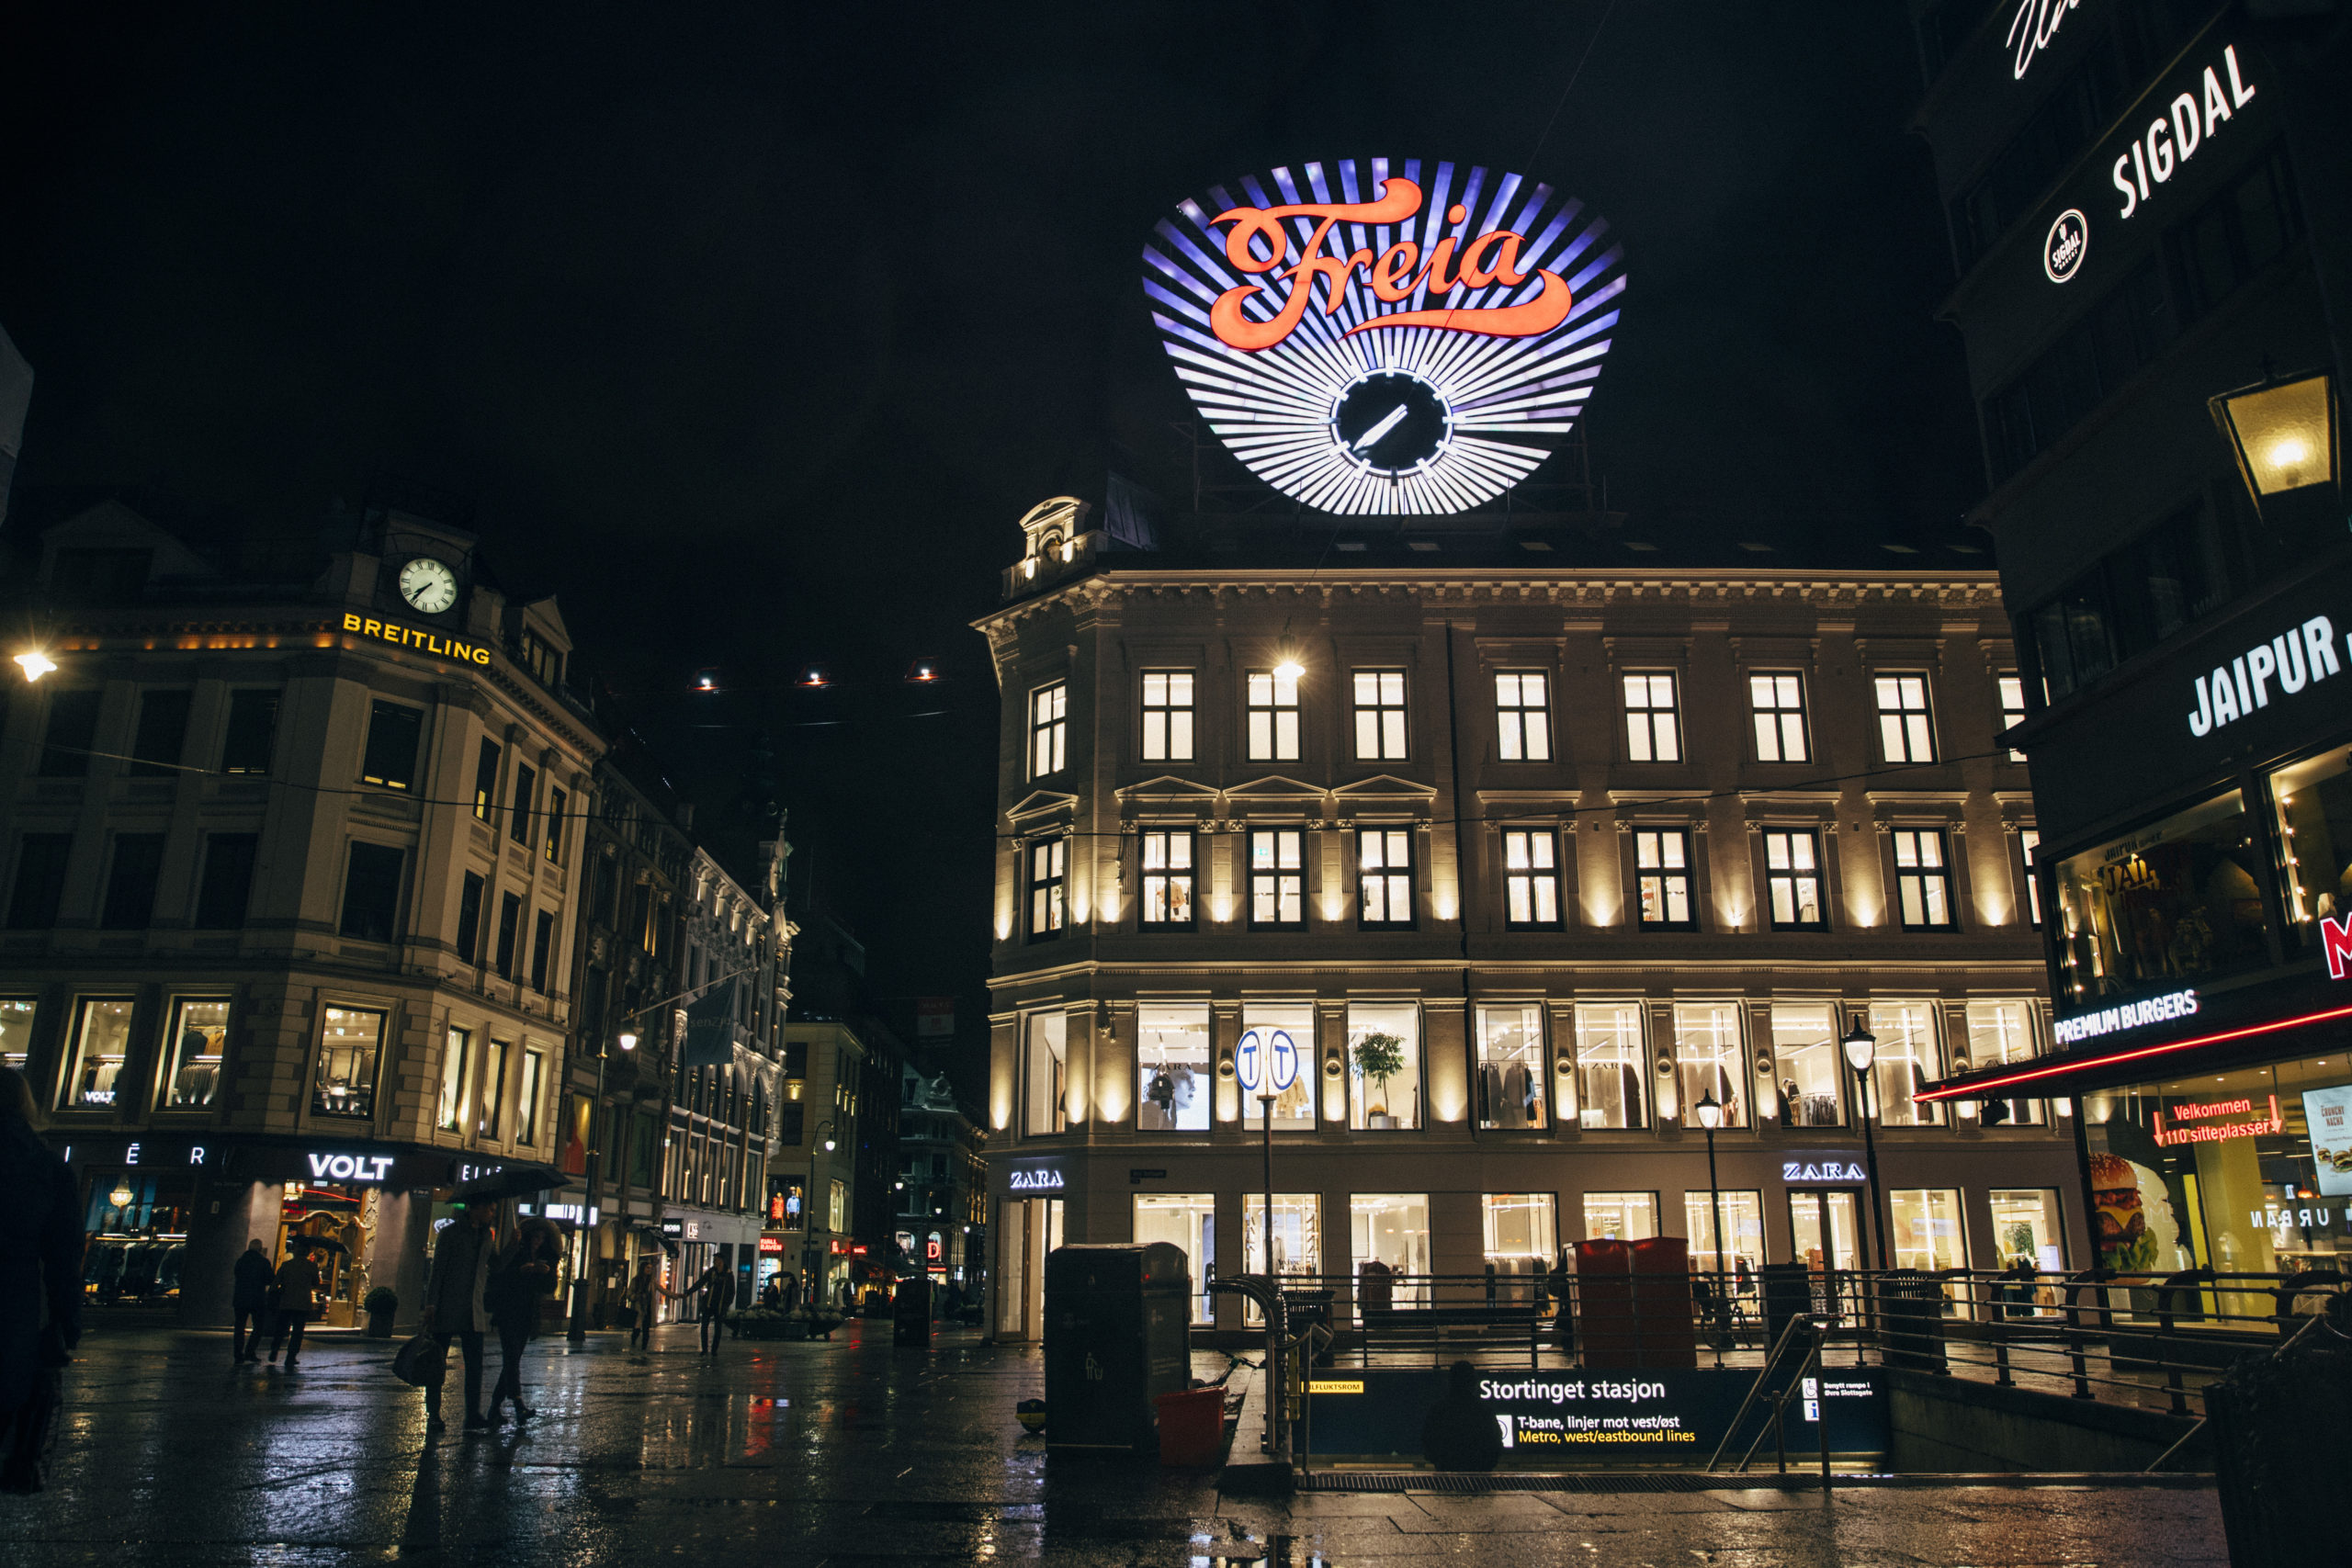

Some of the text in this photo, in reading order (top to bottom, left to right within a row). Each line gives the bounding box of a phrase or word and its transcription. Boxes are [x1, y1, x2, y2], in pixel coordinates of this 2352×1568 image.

[2112, 44, 2256, 220] SIGDAL
[2052, 230, 2082, 268] SIGDAL
[1209, 177, 1572, 353] Freia
[343, 613, 491, 665] BREITLING
[2188, 615, 2341, 738] JAIPUR
[2053, 988, 2199, 1044] PREMIUM BURGERS
[85, 1091, 116, 1104] VOLT
[2174, 1099, 2251, 1121] Velkommen
[2165, 1121, 2271, 1145] 110 sitteplasser
[308, 1154, 394, 1180] VOLT
[1010, 1169, 1064, 1189] ZARA
[1783, 1162, 1866, 1181] ZARA
[927, 1242, 941, 1258] D
[1479, 1378, 1665, 1404] Stortinget stasjon
[1518, 1416, 1680, 1431] T-bane, linjer mot vest/øst
[1519, 1429, 1696, 1444] Metro, west/eastbound lines
